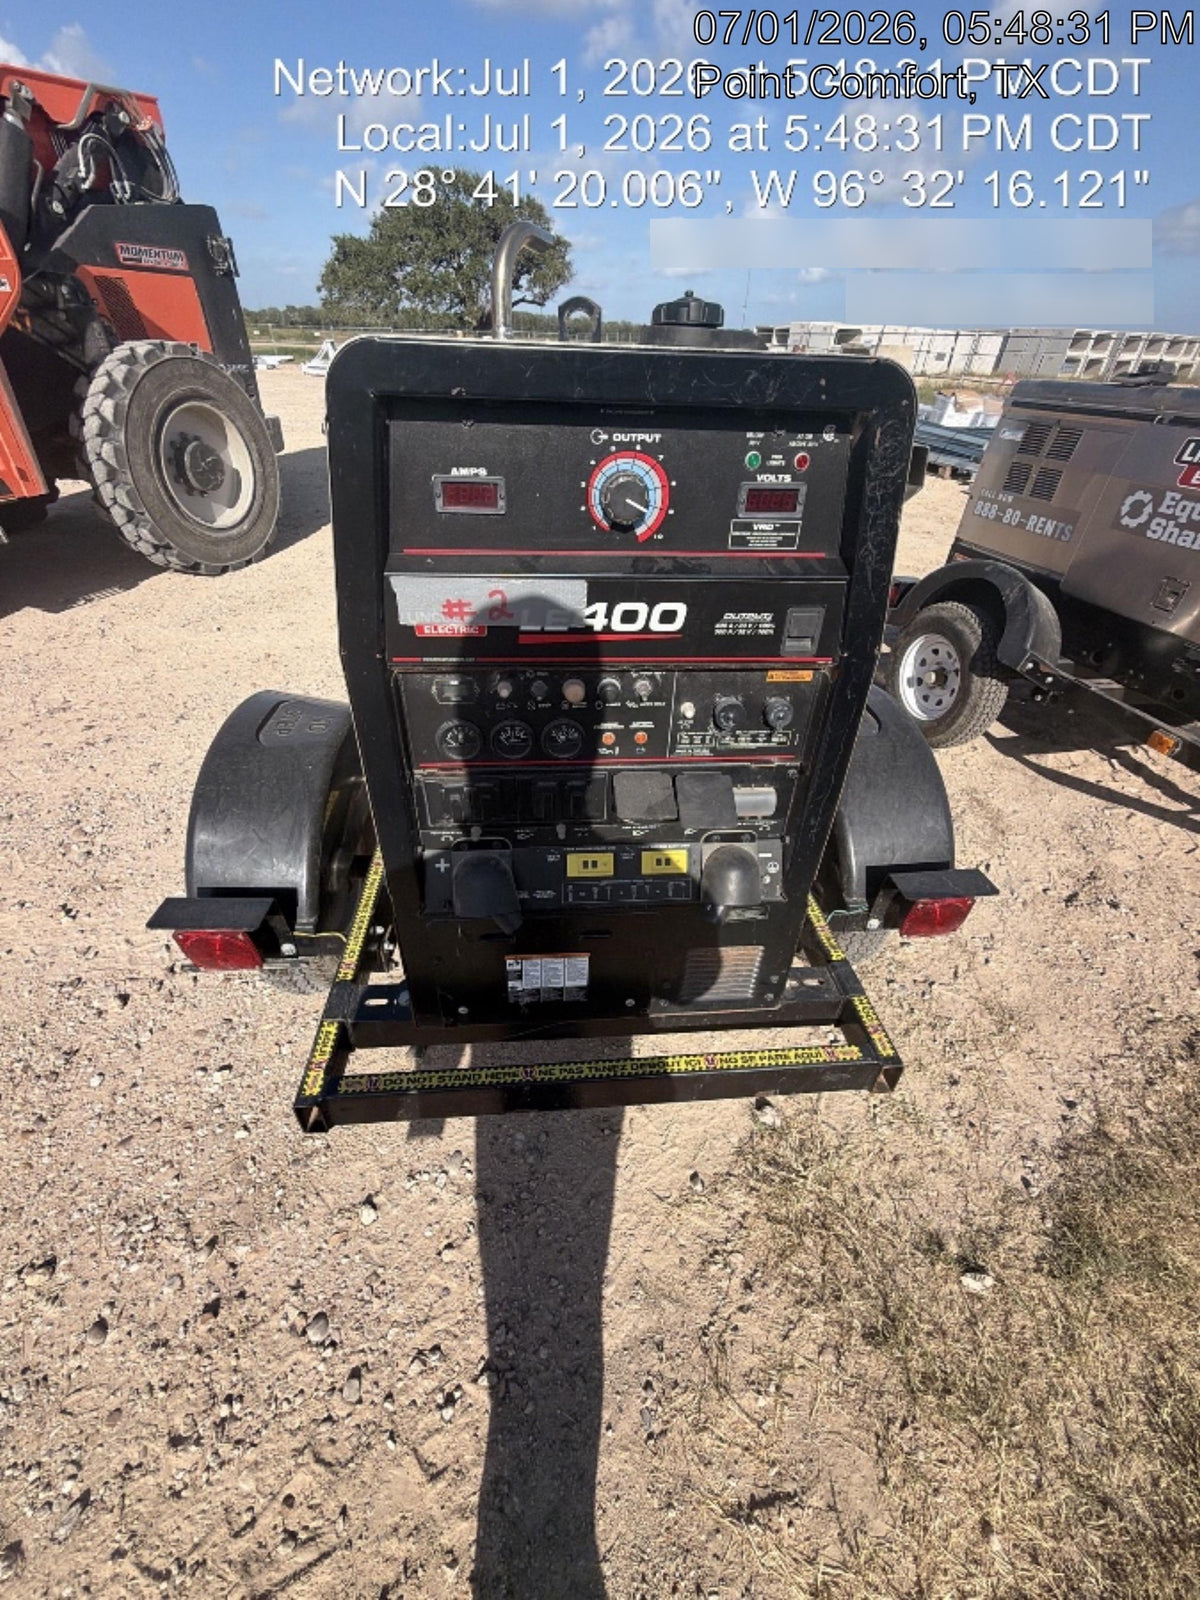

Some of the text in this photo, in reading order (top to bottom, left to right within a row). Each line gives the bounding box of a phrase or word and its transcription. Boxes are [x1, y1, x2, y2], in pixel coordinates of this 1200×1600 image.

[120, 245, 184, 262] MOMENTUM
[612, 433, 662, 443] OUTPUT
[450, 467, 488, 476] AMPS
[756, 474, 792, 483] VOLTS
[974, 500, 1074, 542] 888-80-RENTS
[424, 626, 480, 635] ELECTRIC
[383, 1071, 521, 1087] DO NOT STAND HERE
